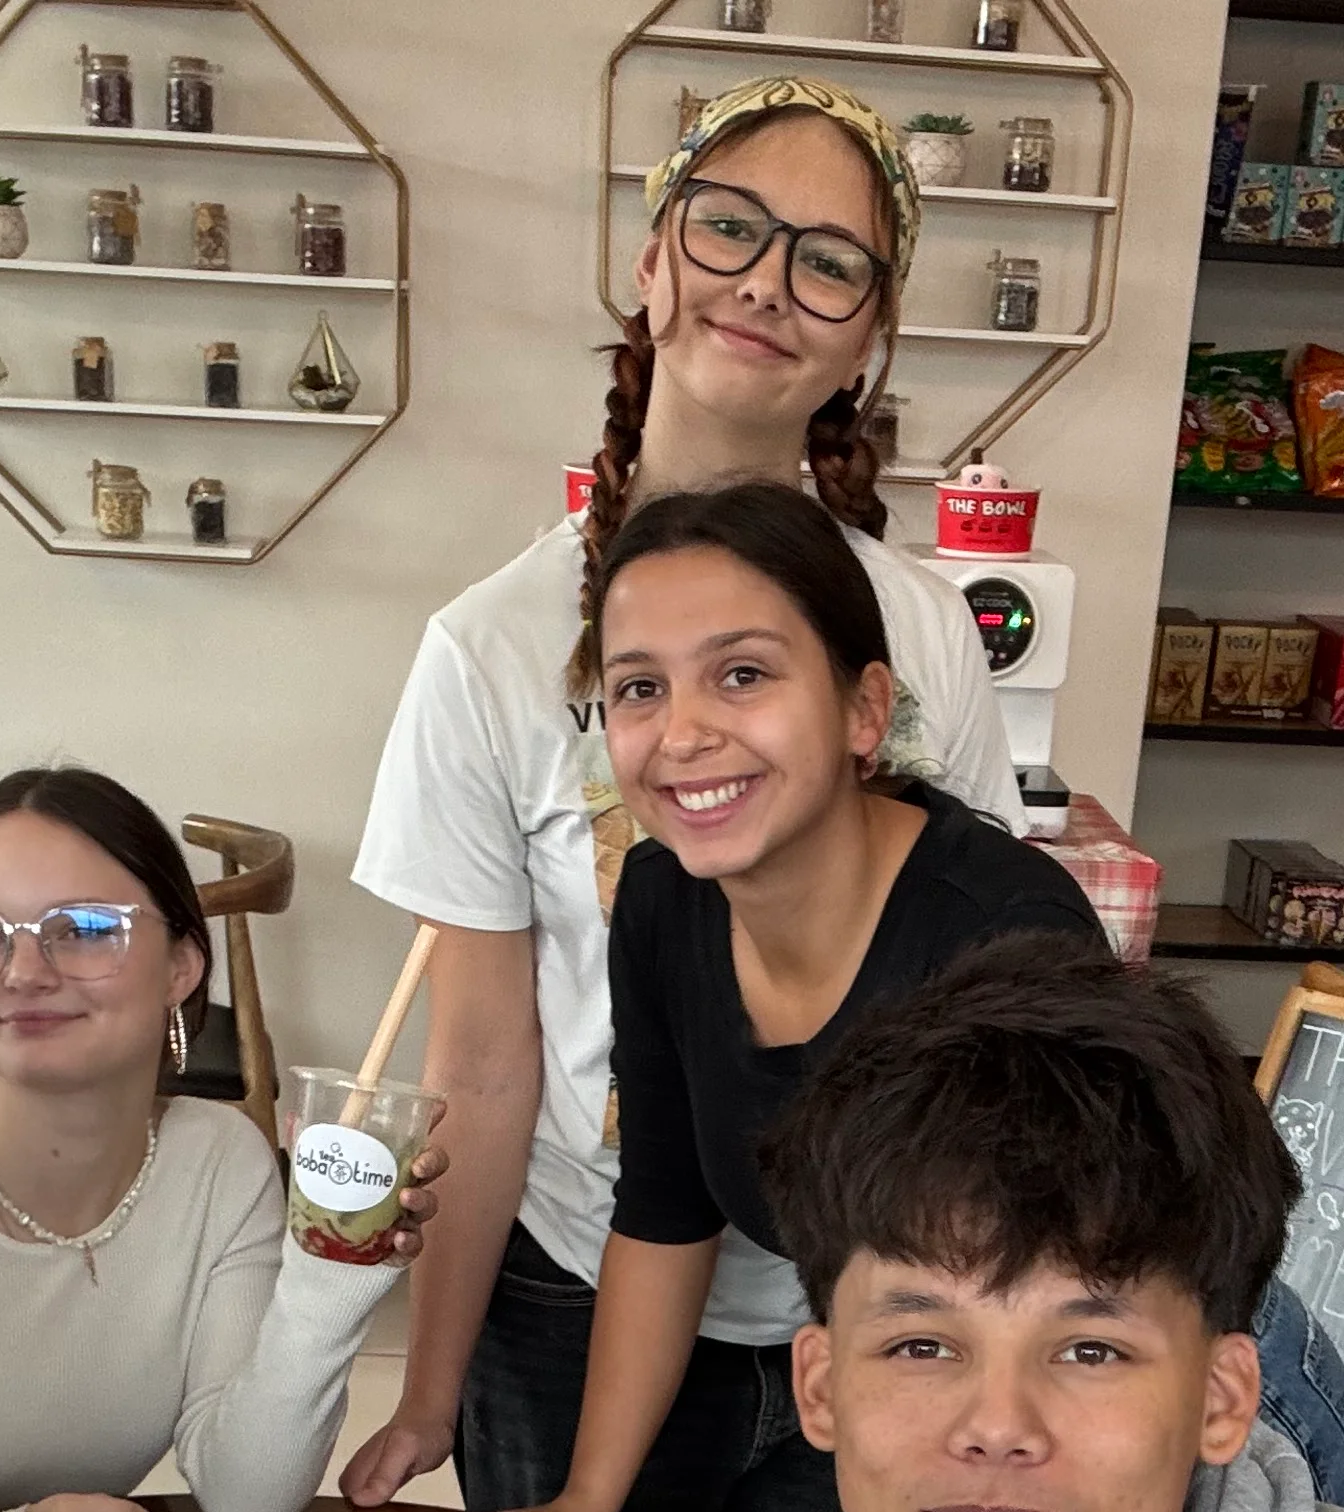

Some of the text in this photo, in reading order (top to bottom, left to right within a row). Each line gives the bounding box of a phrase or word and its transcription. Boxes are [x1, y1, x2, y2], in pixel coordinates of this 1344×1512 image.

[946, 497, 1026, 517] THE BOWL
[296, 1144, 328, 1175] boba
[353, 1160, 394, 1188] time
